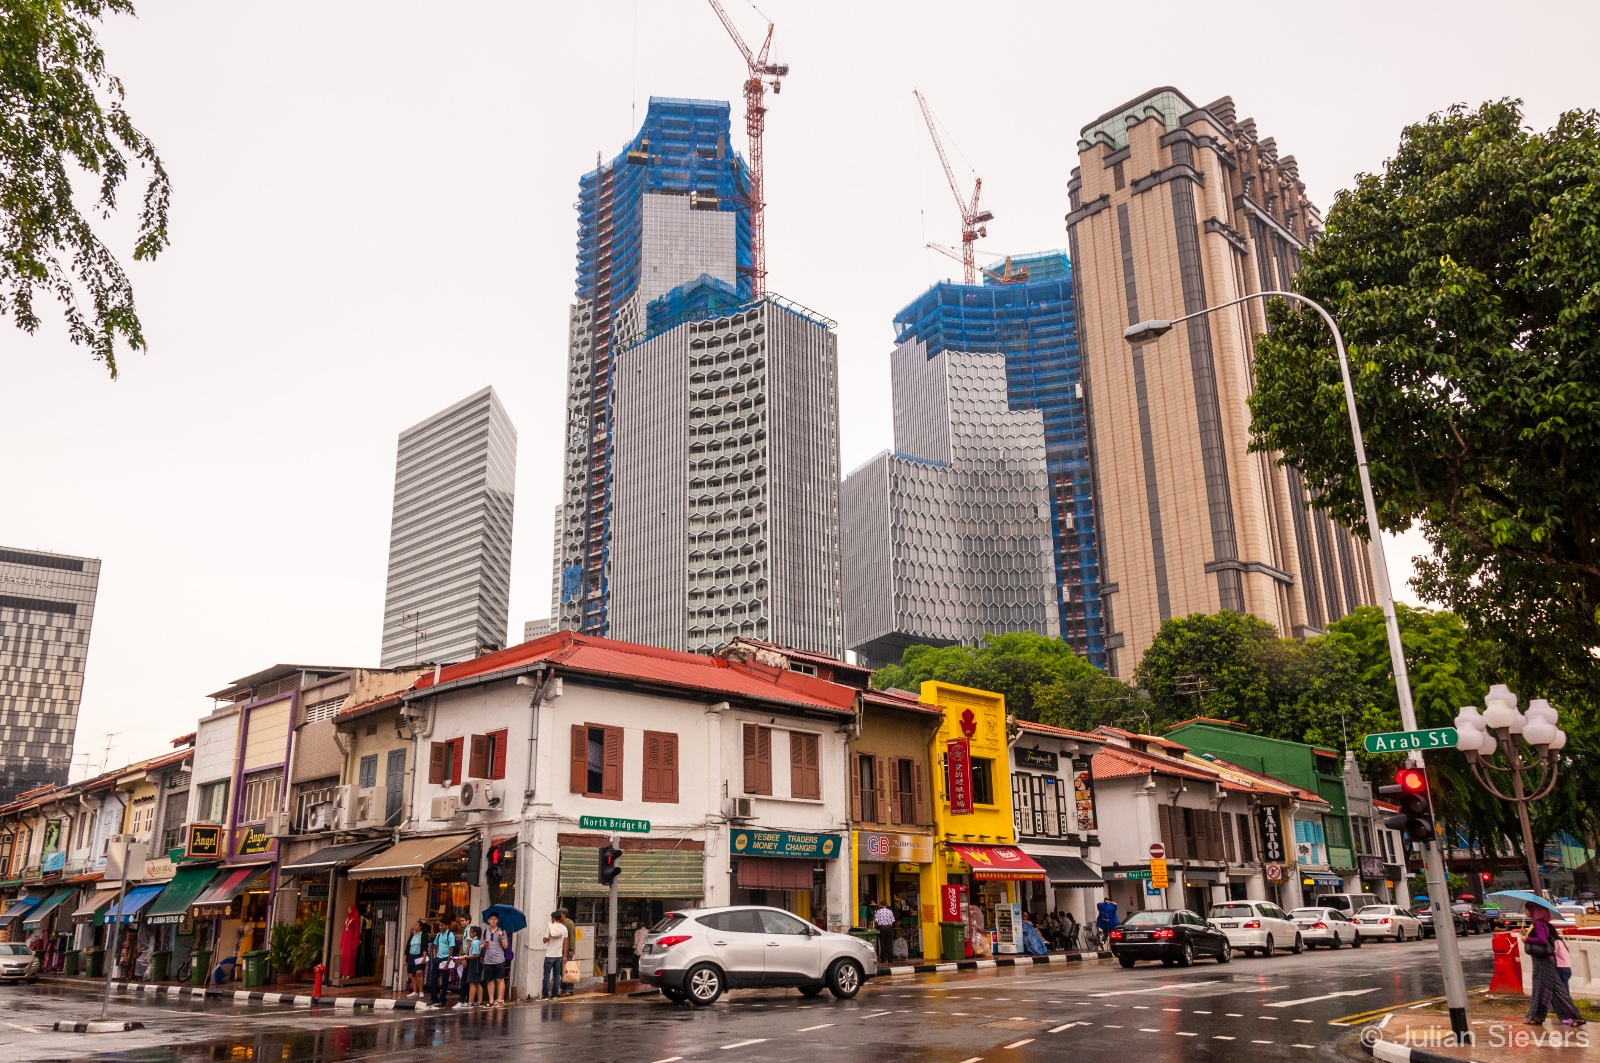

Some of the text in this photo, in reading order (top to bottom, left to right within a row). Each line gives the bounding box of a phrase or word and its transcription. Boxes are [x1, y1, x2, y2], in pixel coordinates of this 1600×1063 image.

[1, 572, 52, 589] PACIFIC
[1376, 732, 1448, 750] Arab St
[584, 818, 647, 830] North Bridge Rd
[1264, 806, 1280, 859] TATTOO
[193, 832, 216, 850] Angel
[752, 842, 778, 850] MONEY
[754, 833, 818, 844] YESBEE TRADERS
[868, 836, 890, 854] GB
